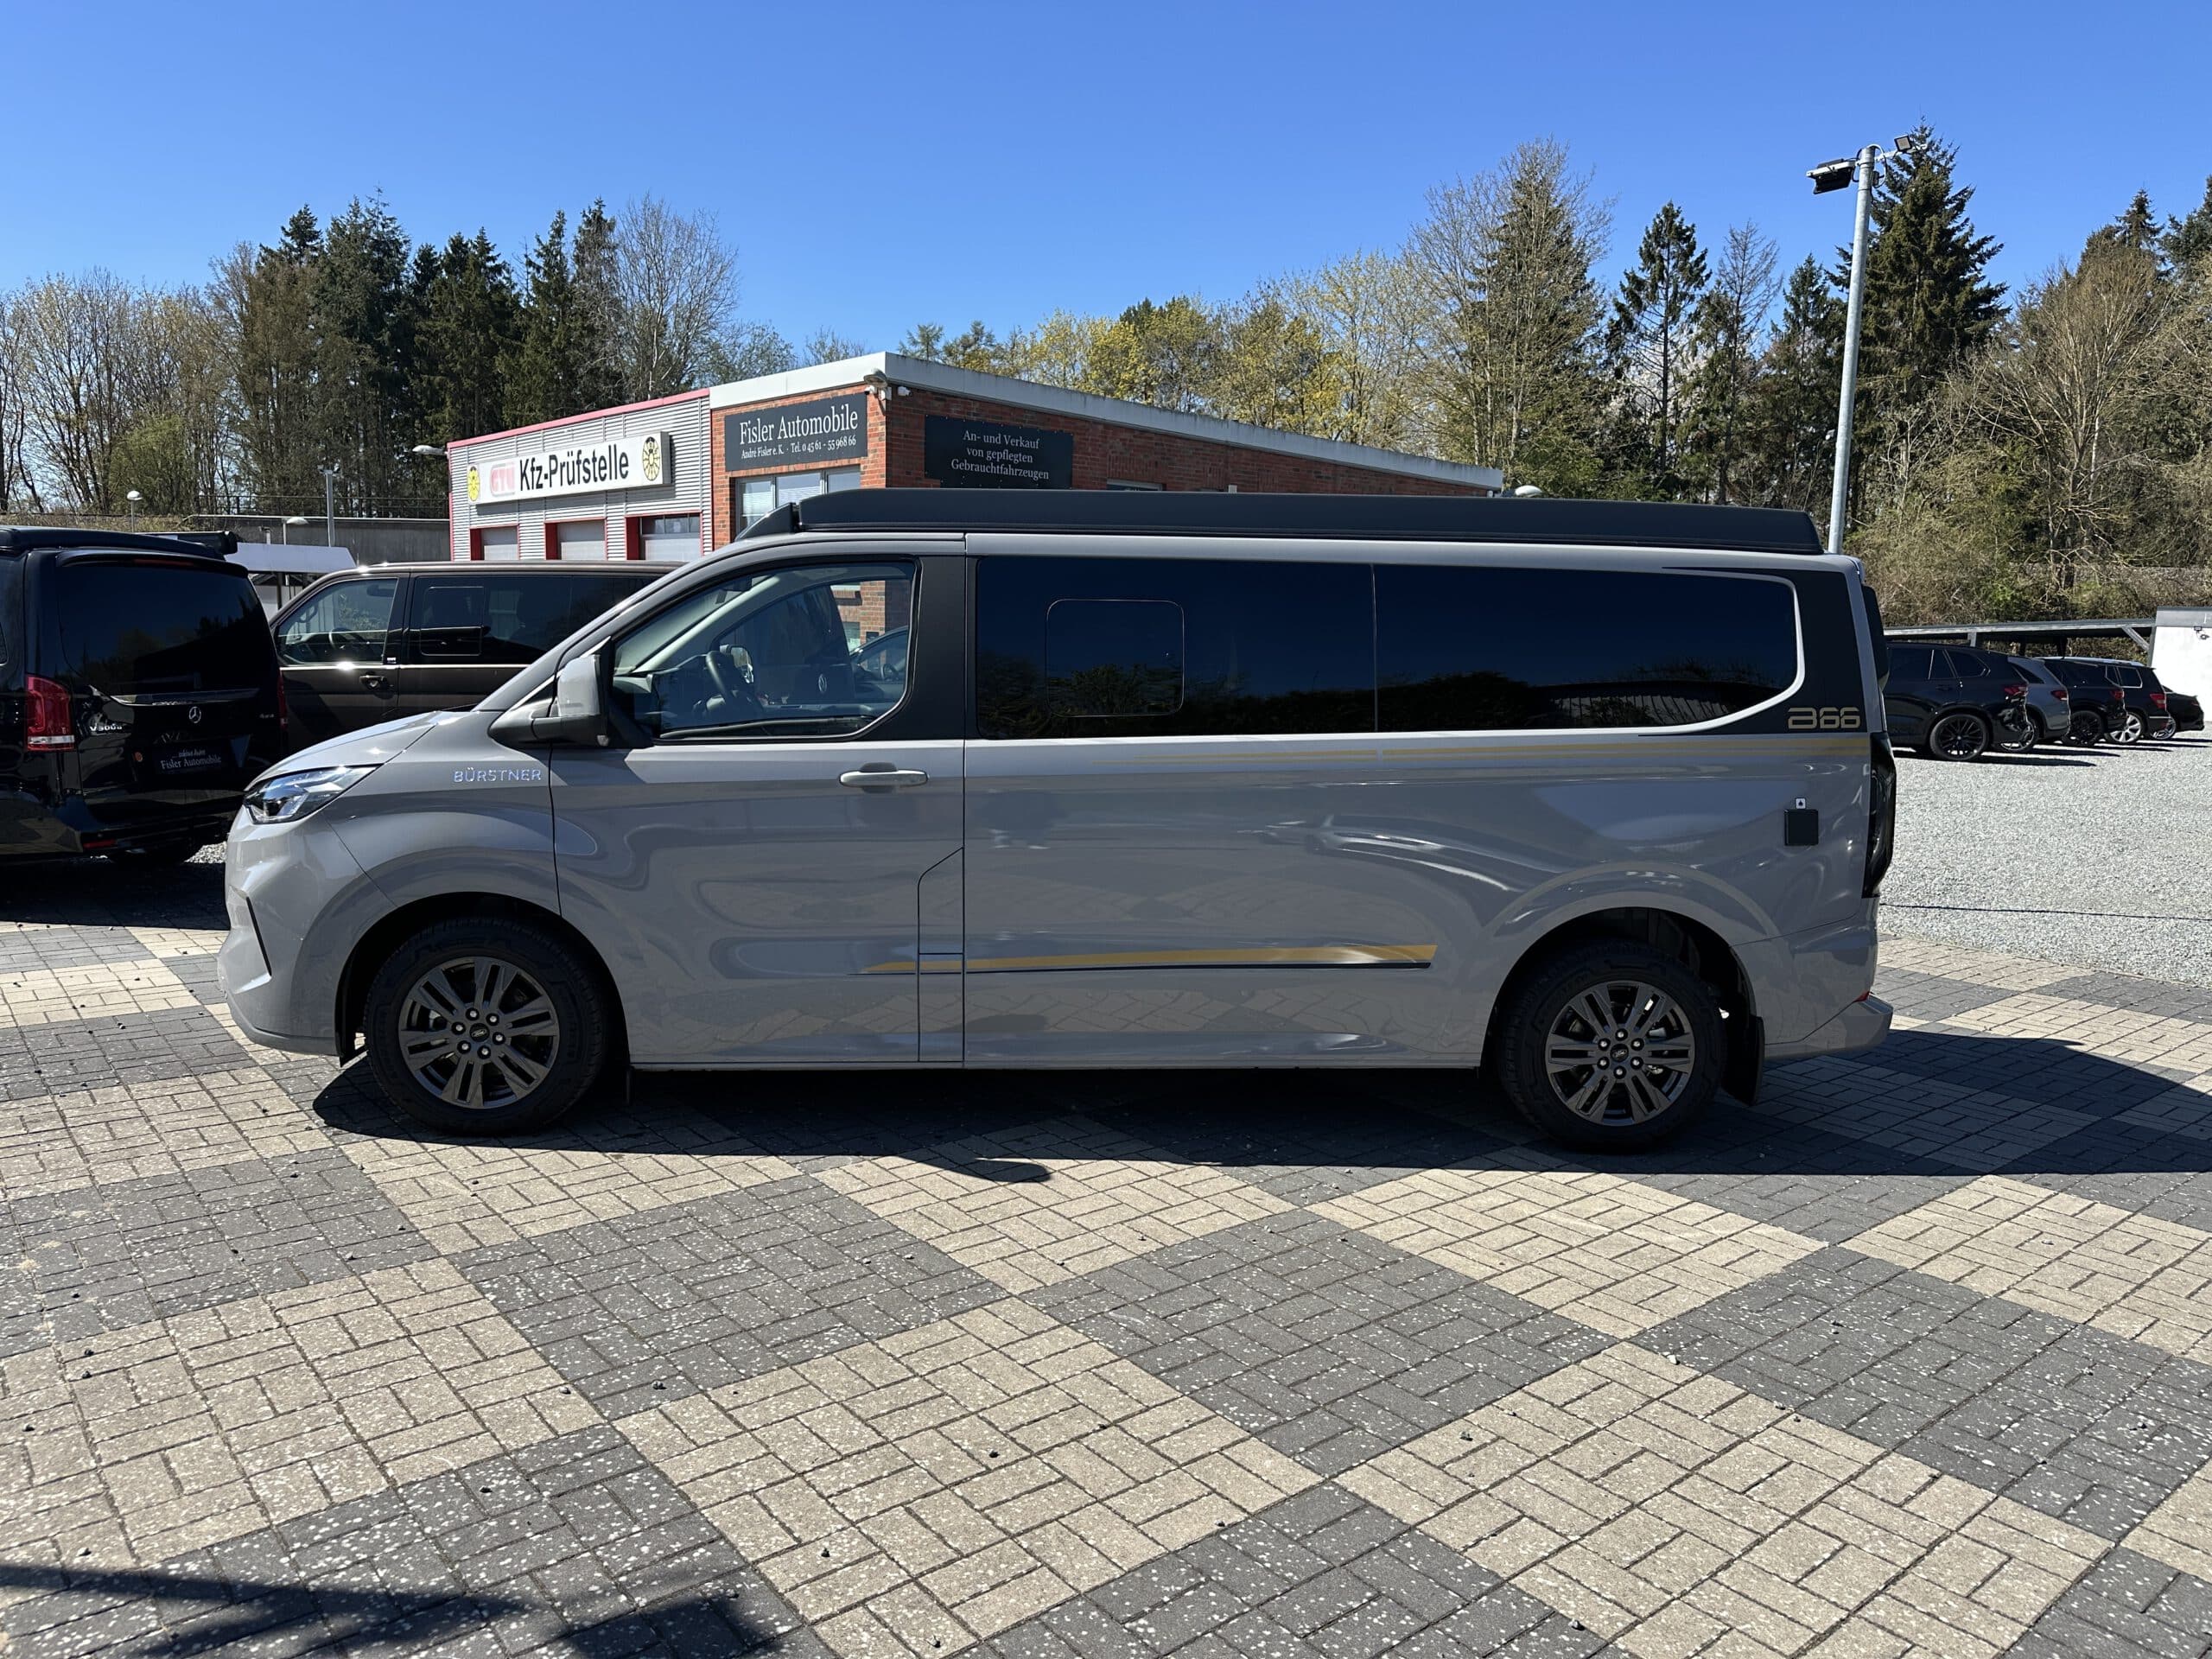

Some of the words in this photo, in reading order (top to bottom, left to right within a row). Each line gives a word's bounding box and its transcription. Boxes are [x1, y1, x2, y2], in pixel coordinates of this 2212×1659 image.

[739, 417, 774, 445] Fisler
[778, 404, 858, 440] Automobile
[963, 430, 982, 442] An-
[983, 433, 1001, 445] und
[1003, 435, 1040, 449] Verkauf
[757, 445, 772, 457] Fisler
[966, 447, 984, 458] von
[986, 448, 1033, 464] gepflegten
[519, 443, 629, 492] Kfz-Prüfstelle
[950, 458, 1050, 480] Gebrauchtfahrzeugen
[453, 766, 542, 783] BÜRSTNER
